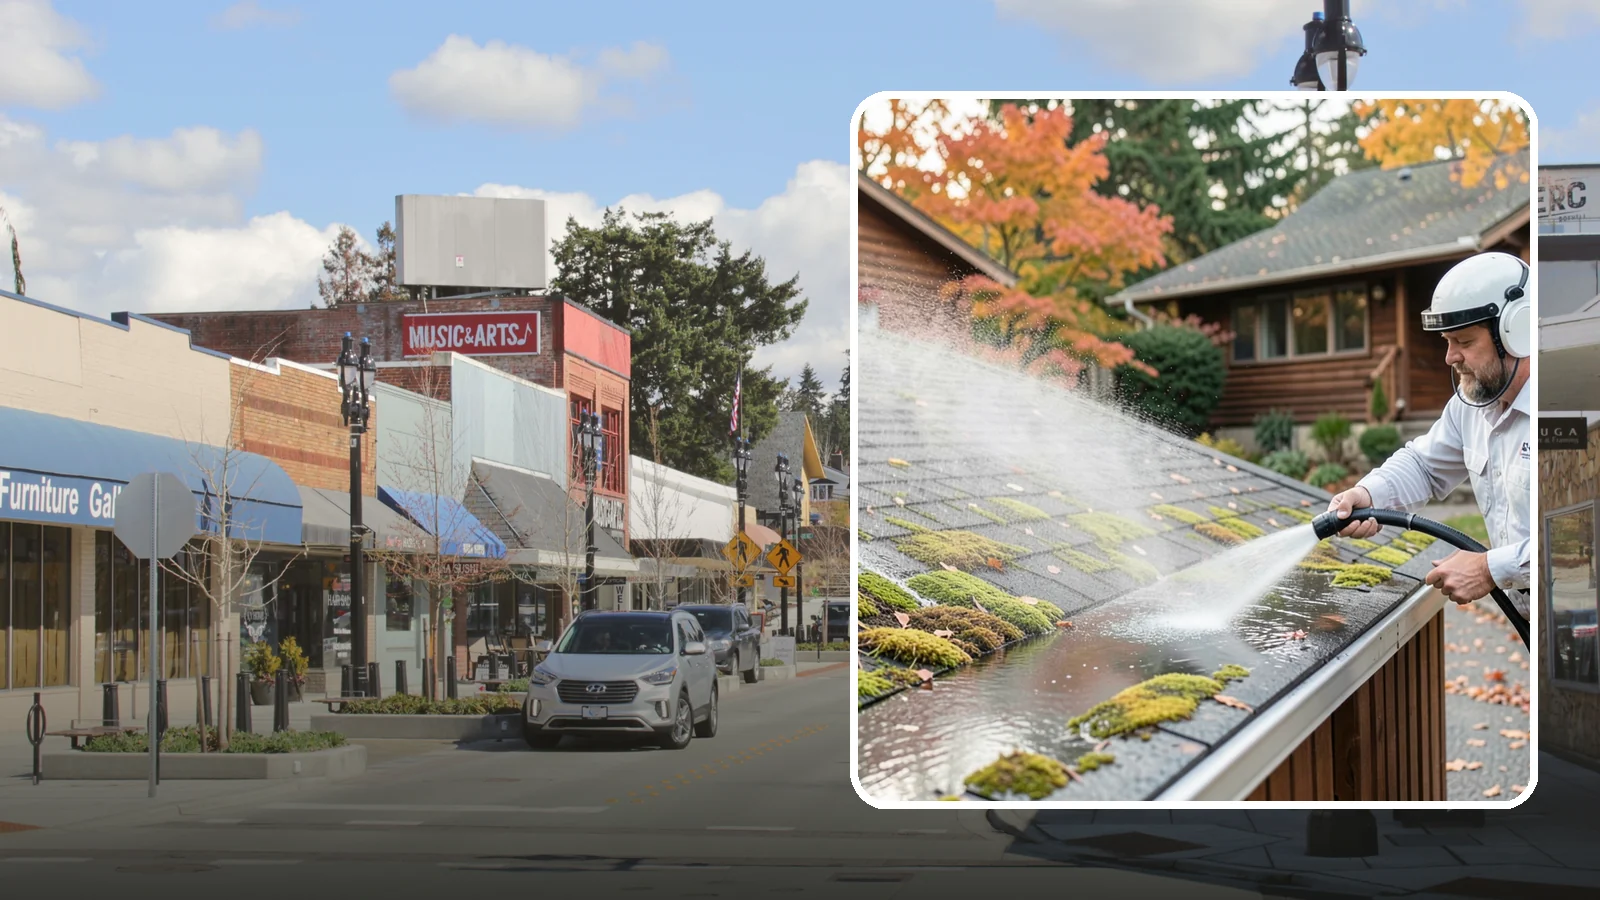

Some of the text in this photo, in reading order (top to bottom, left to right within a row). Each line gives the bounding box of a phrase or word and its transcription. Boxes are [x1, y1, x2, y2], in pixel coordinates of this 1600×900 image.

[409, 323, 519, 349] MUSIC&ARTS
[1540, 427, 1577, 437] UGA
[0, 471, 122, 519] Furniture Gal
[454, 563, 480, 574] SUSHI
